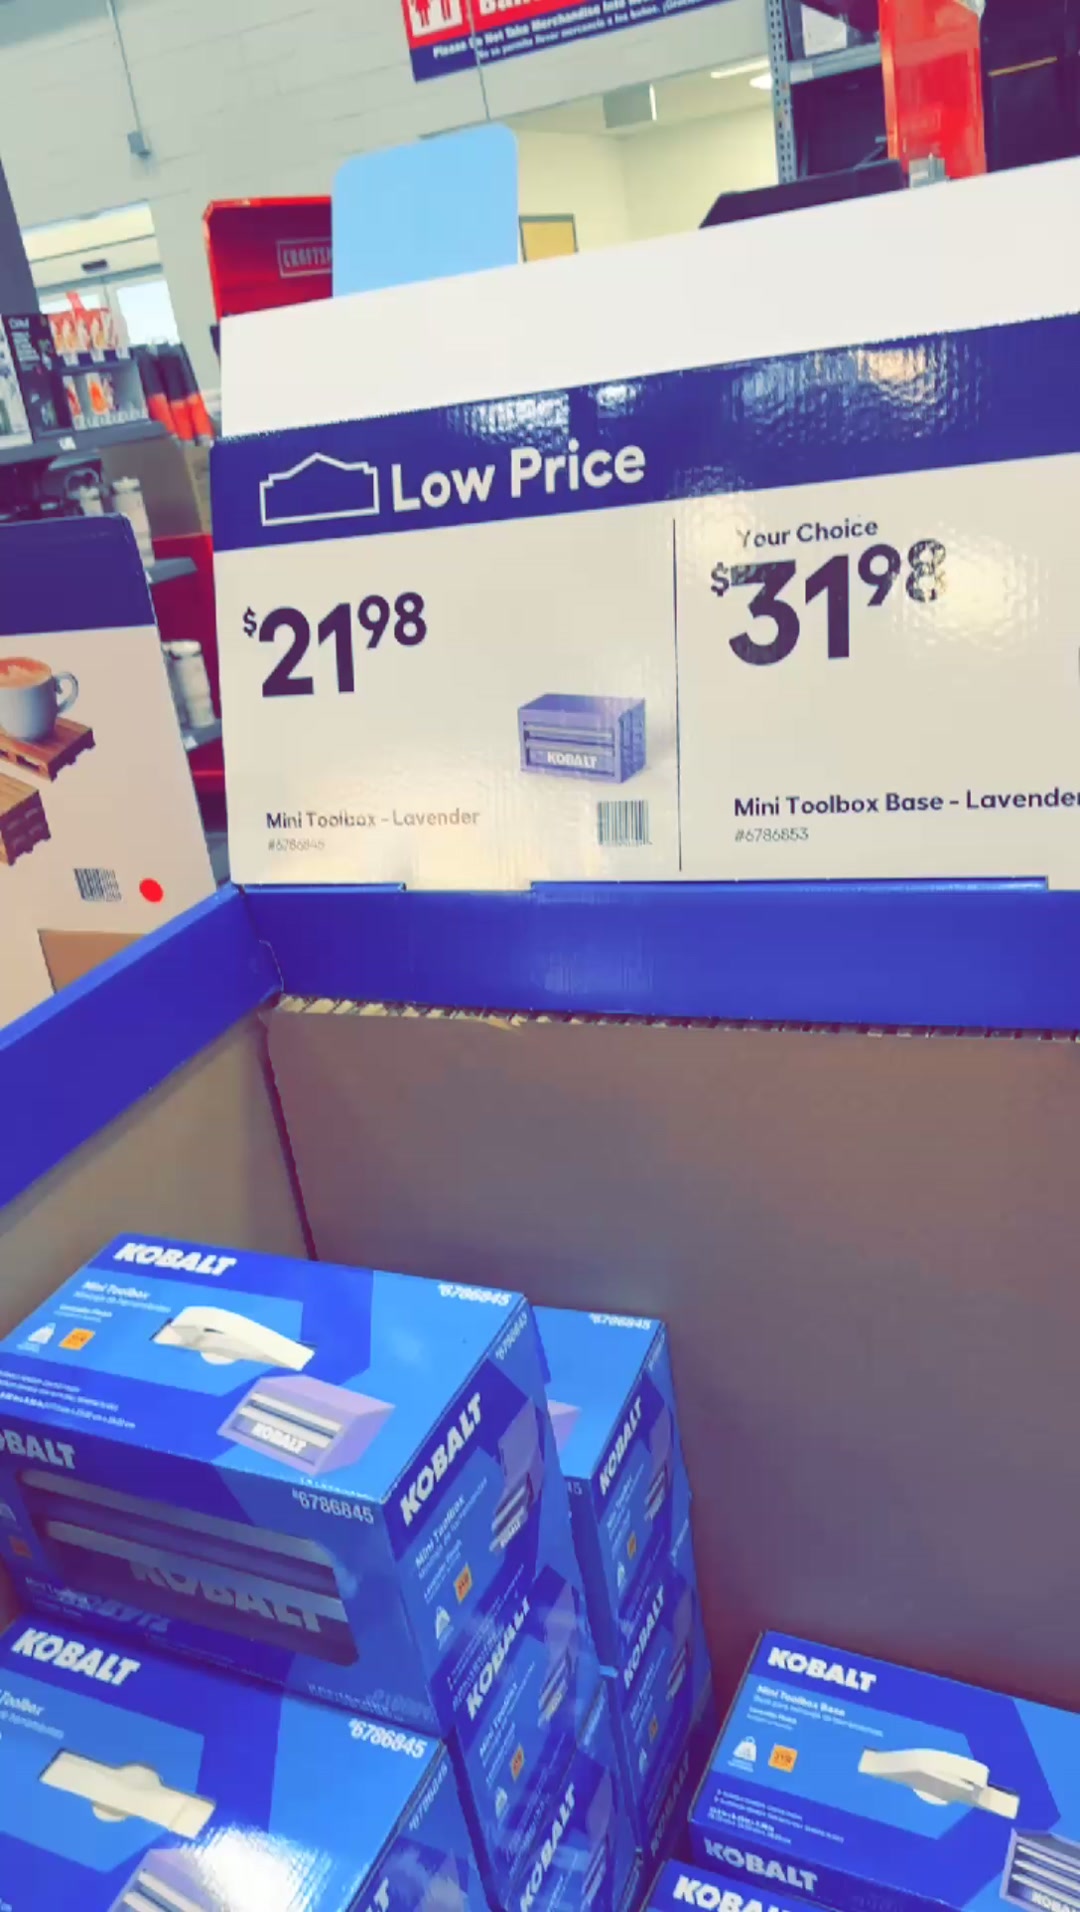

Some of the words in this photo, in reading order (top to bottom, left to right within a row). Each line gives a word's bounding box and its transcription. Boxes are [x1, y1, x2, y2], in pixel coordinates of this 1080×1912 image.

[432, 41, 467, 59] Please
[484, 29, 504, 45] Not
[505, 23, 530, 38] Take
[531, 4, 601, 32] Merchandise
[283, 246, 331, 268] CRAFTS
[391, 464, 496, 512] Low
[510, 438, 646, 498] Price
[736, 527, 791, 549] Your
[796, 517, 879, 544] Choice
[547, 751, 598, 769] KOBALT
[266, 811, 302, 829] Mini
[306, 810, 376, 829] Toolbox
[392, 807, 481, 826] Lavender
[734, 796, 780, 816] Mini
[786, 794, 879, 815] Toolbox
[885, 792, 944, 812] Base
[734, 827, 809, 842] #6786853
[113, 1242, 237, 1276] KOBALT
[0, 1428, 76, 1470] BALT
[252, 1421, 307, 1454] KOBALT
[600, 1396, 643, 1496] KOBALT
[400, 1392, 483, 1526] KOBALT
[11, 1627, 141, 1687] KOBALT
[624, 1583, 664, 1691] KOBALT
[767, 1647, 877, 1693] KOBALT
[704, 1837, 818, 1894] KOBALT
[673, 1874, 791, 1912] KOBA
